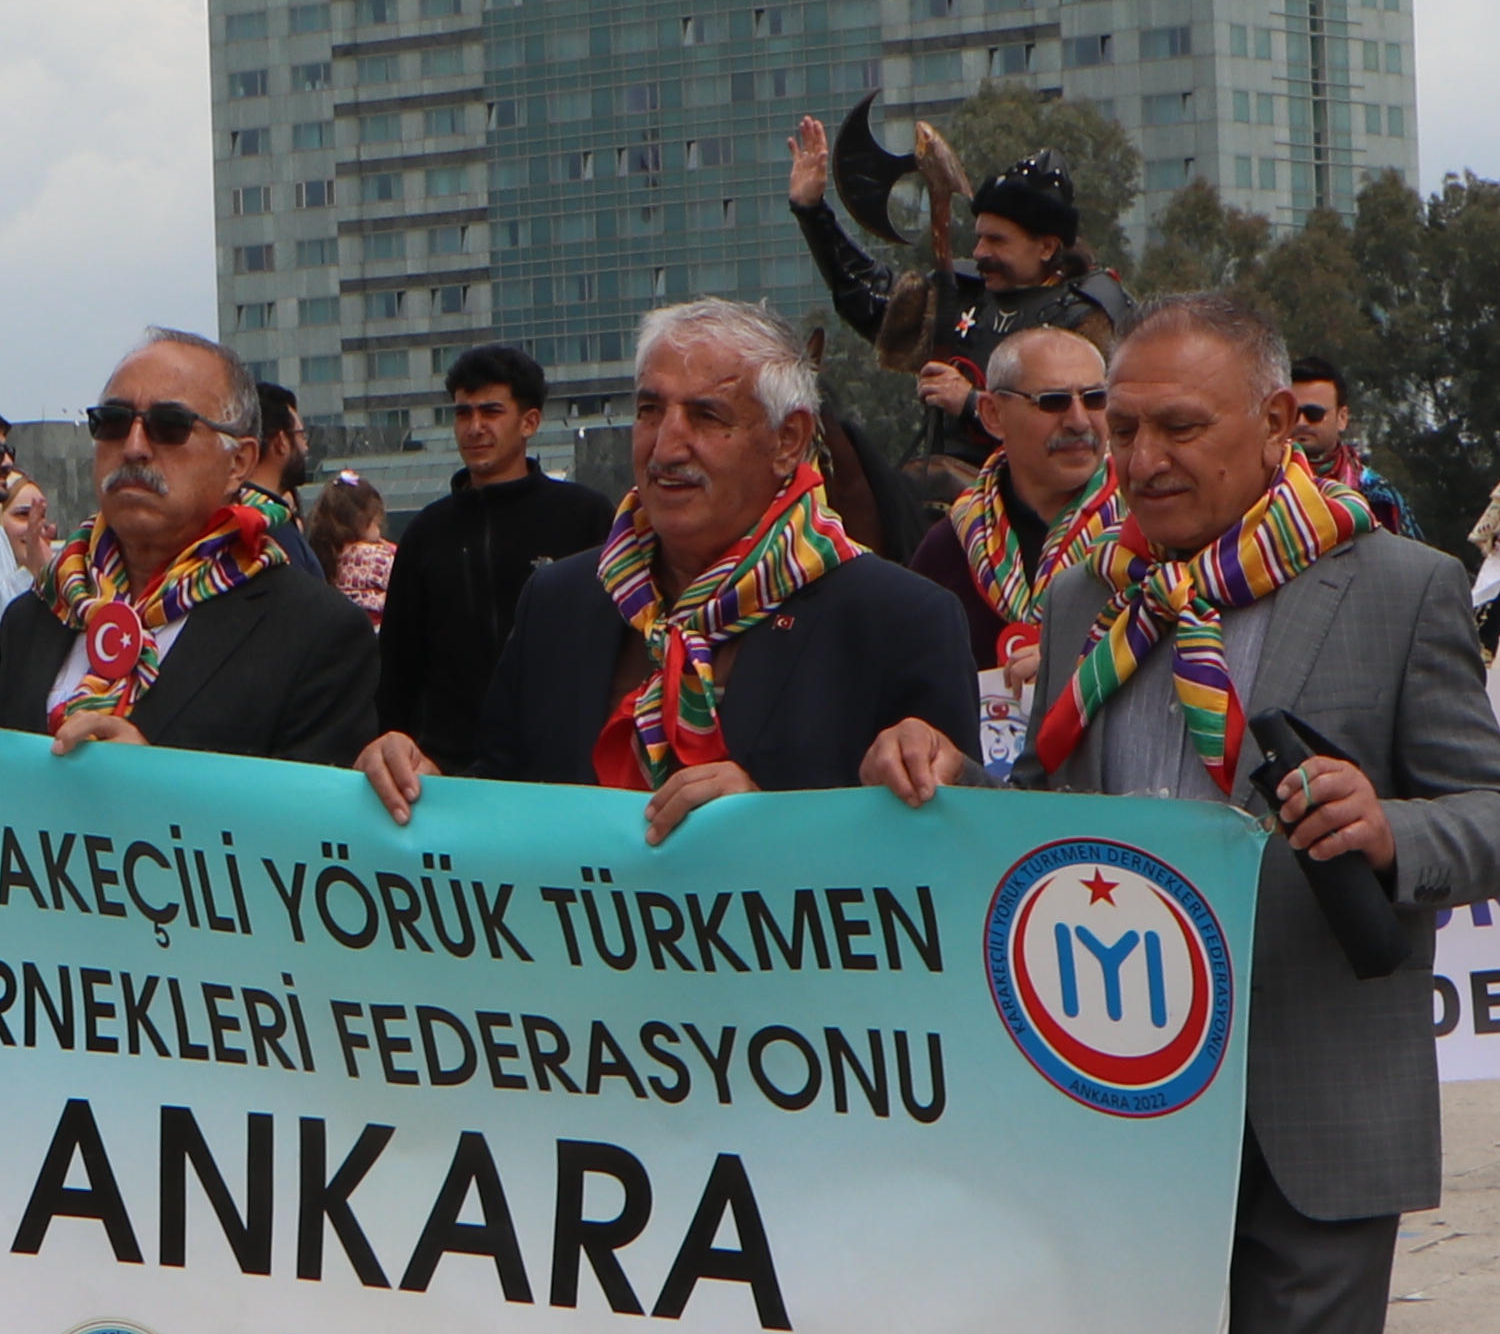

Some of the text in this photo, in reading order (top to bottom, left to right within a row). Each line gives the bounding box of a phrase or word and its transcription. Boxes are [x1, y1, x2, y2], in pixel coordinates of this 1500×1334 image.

[261, 842, 535, 962] YÖRÜK
[539, 866, 945, 973] TÜRKMEN
[1107, 848, 1210, 923] DERNEKLERİ
[1199, 919, 1229, 1060] FEDERASYONU
[329, 999, 947, 1124] FEDERASYONU
[1069, 1079, 1168, 1111] ANKARA 2022
[9, 1098, 793, 1332] ANKARA
